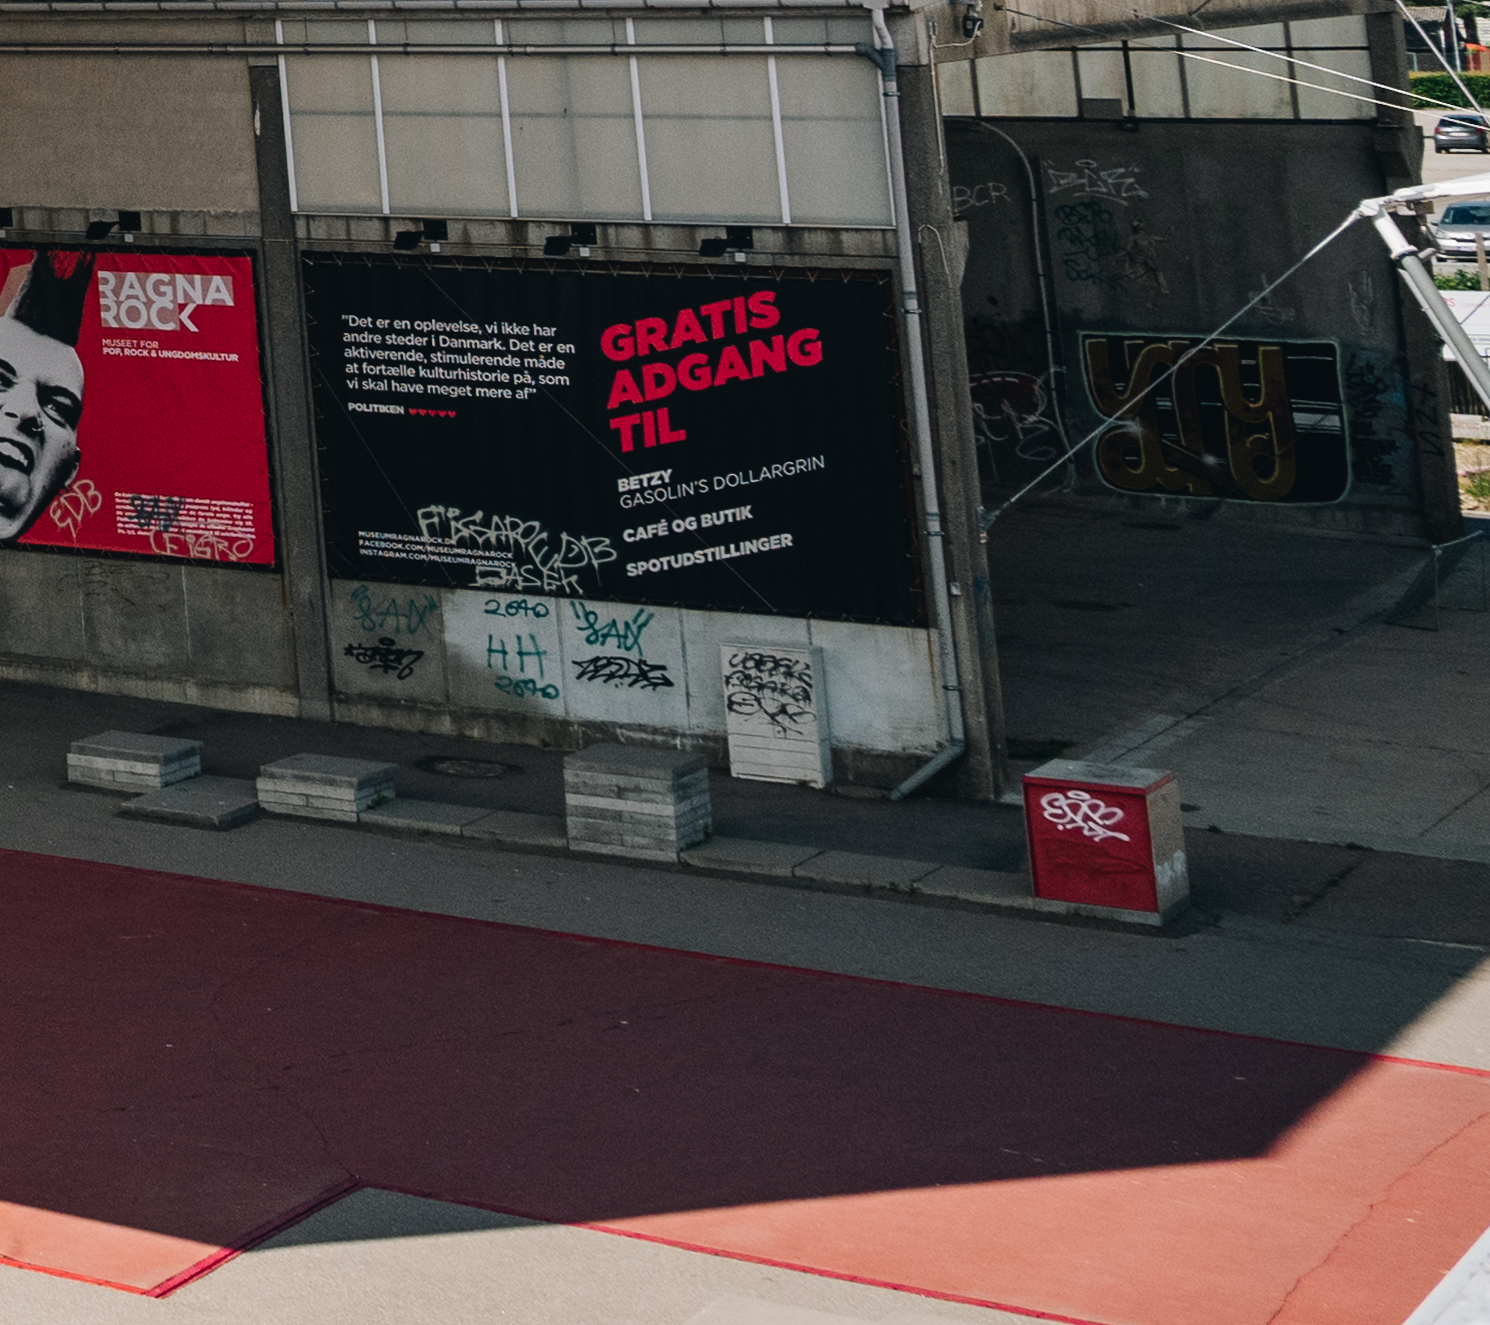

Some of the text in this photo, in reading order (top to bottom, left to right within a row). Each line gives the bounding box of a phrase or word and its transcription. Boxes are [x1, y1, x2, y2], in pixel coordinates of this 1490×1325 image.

[97, 271, 235, 306] RAGNA
[100, 298, 200, 332] ROCK
[376, 318, 390, 329] er
[393, 319, 411, 330] en
[414, 318, 482, 335] oplevelse,
[484, 321, 498, 334] vi
[501, 322, 530, 336] ikke
[533, 323, 556, 337] har
[600, 290, 781, 362] GRATIS
[102, 338, 159, 349] MUSEET FOR
[102, 347, 239, 363] POP, ROCK & UNGDOMSKULTUR
[343, 331, 382, 344] andre
[385, 333, 429, 346] steder
[439, 335, 506, 351] Danmark.
[509, 338, 536, 352] Det
[538, 342, 554, 353] er
[556, 343, 576, 354] en
[344, 345, 566, 370] aktiverende, stimulerende måde
[606, 327, 824, 410] ADGANG
[345, 362, 570, 387] at fortælle kulturhistorie på, som
[346, 377, 359, 389] vi
[362, 377, 388, 391] skal
[391, 379, 424, 394] have
[427, 384, 472, 398] meget
[475, 388, 513, 399] mere
[347, 402, 405, 415] POLITIKEN
[609, 406, 687, 453] TIL
[617, 468, 673, 492] BETZY
[619, 454, 826, 510] GASOLIN'S DOLLARGRIN
[623, 504, 754, 543] CAFÉ OG BUTIK
[358, 539, 514, 560] FACEBOOK.COM/MUSEUMRAGNAROCK
[626, 532, 795, 578] SPOTUDSTILLINGER
